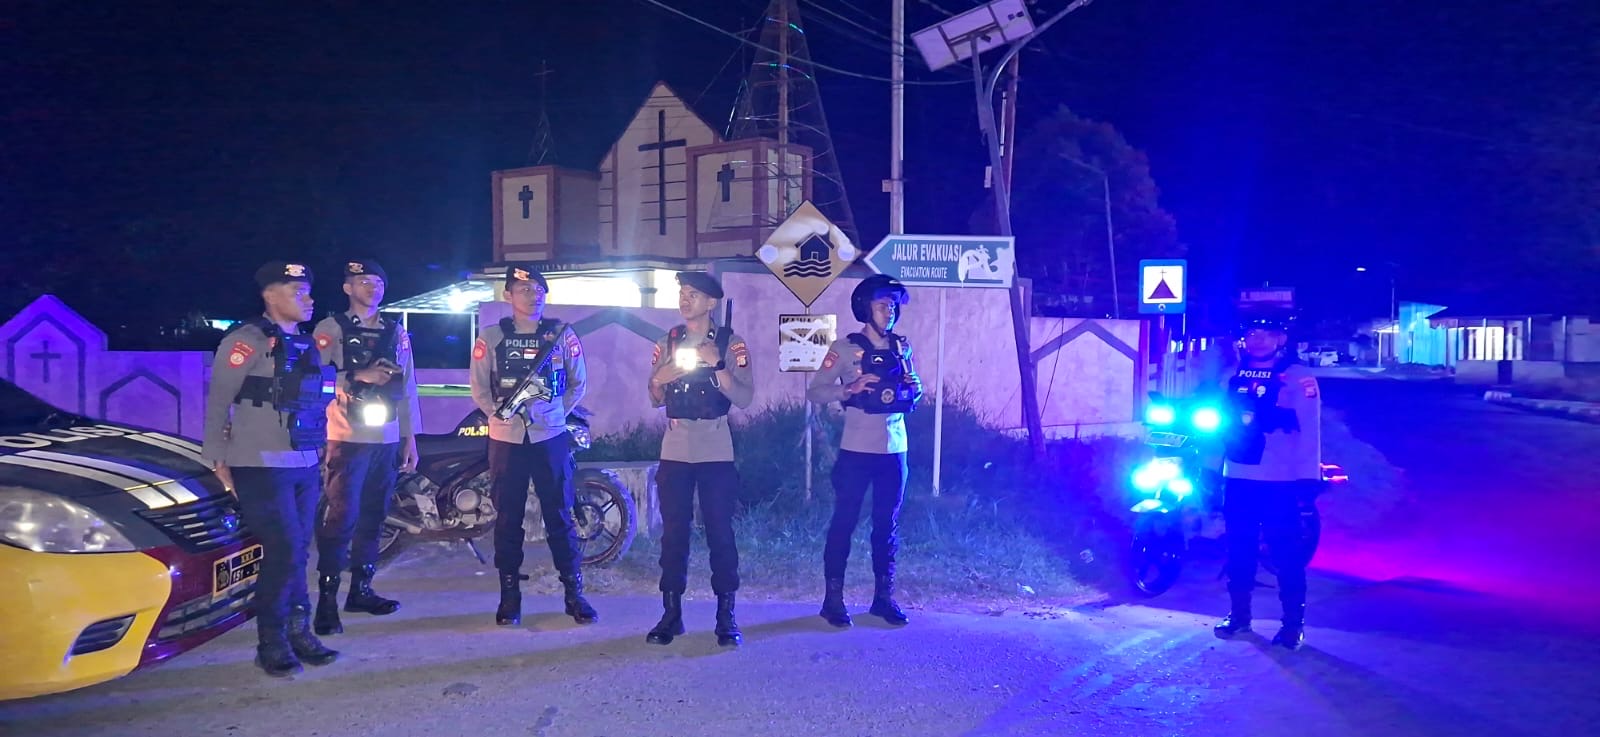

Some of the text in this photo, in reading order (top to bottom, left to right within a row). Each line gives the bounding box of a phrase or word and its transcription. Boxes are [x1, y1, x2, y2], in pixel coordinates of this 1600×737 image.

[892, 243, 962, 262] JALUR EVAKUASI
[900, 266, 948, 279] EVACUATION ROUTE
[505, 339, 539, 348] POLISI
[1238, 369, 1271, 379] POLISI
[0, 424, 141, 449] OLISI
